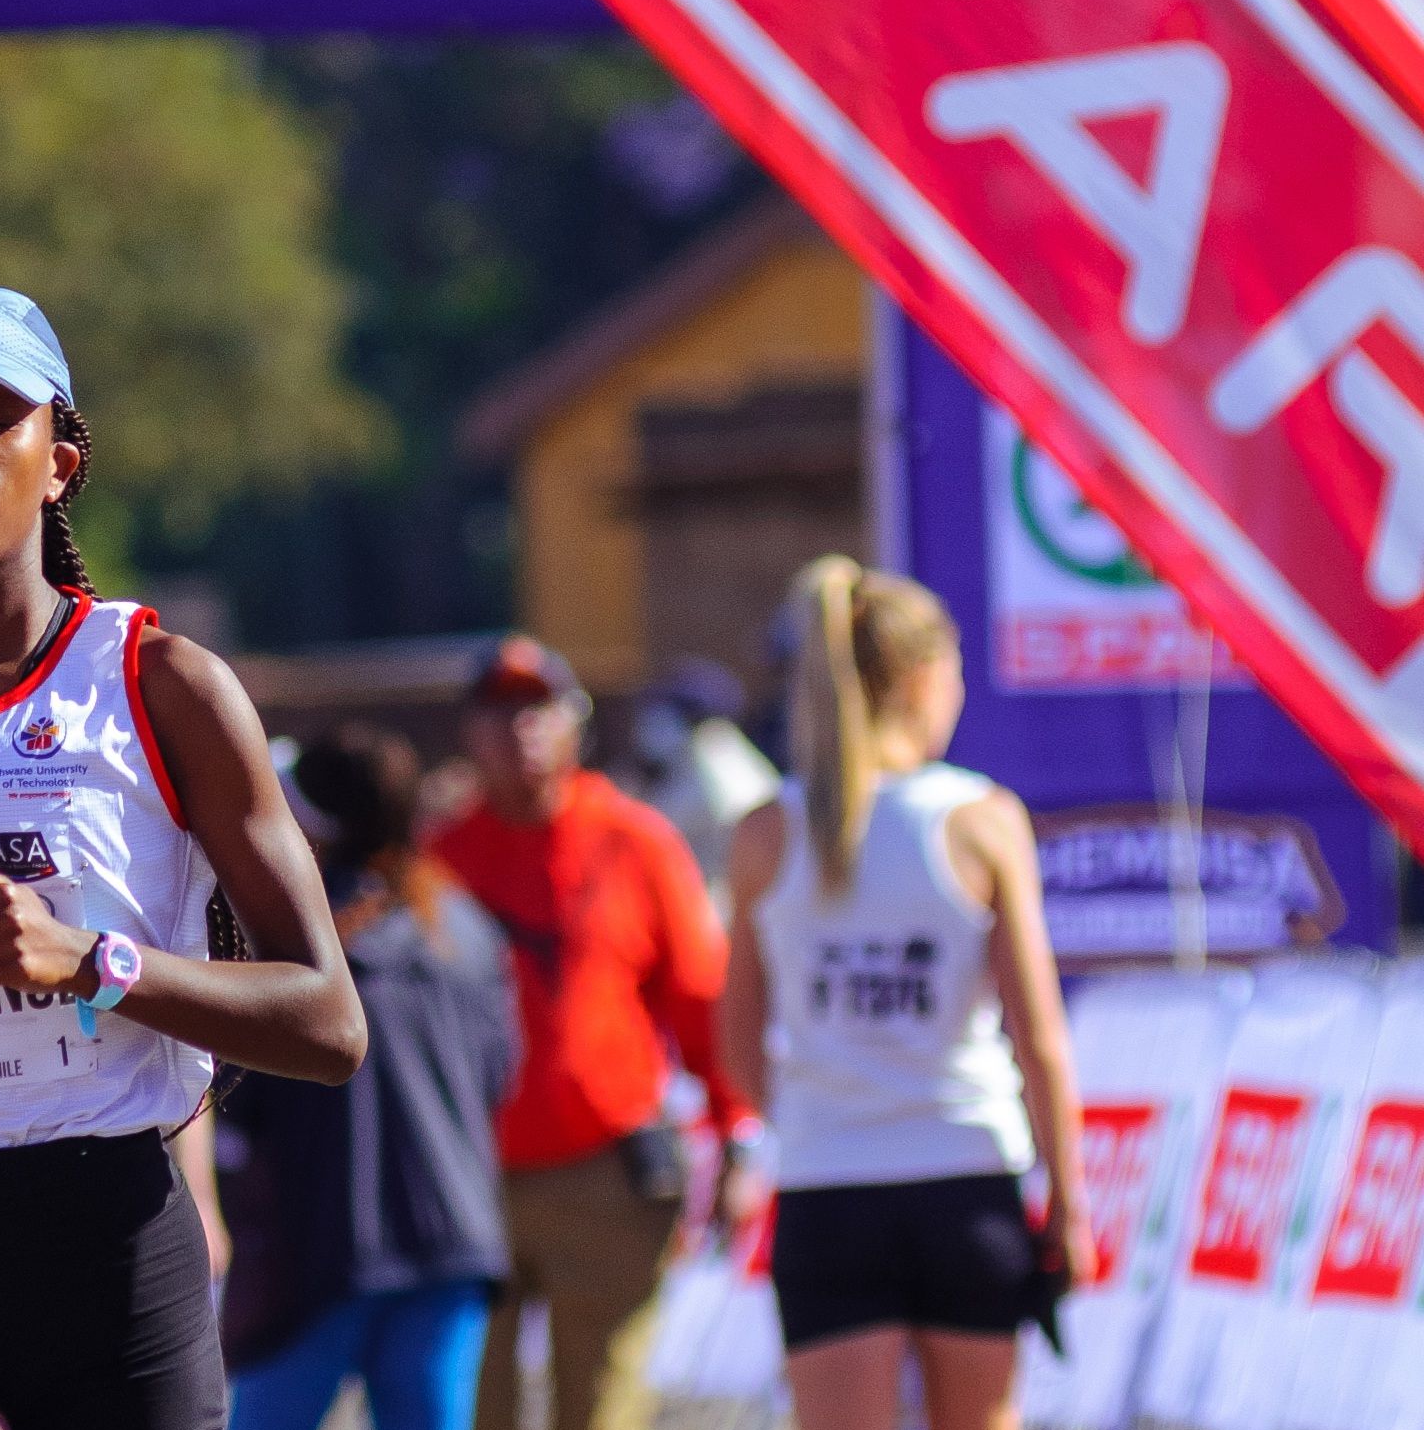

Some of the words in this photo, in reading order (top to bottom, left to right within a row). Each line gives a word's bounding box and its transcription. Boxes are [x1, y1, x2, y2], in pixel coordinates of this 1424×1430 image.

[36, 764, 88, 775] University
[2, 779, 14, 789] of
[17, 778, 75, 788] Technology
